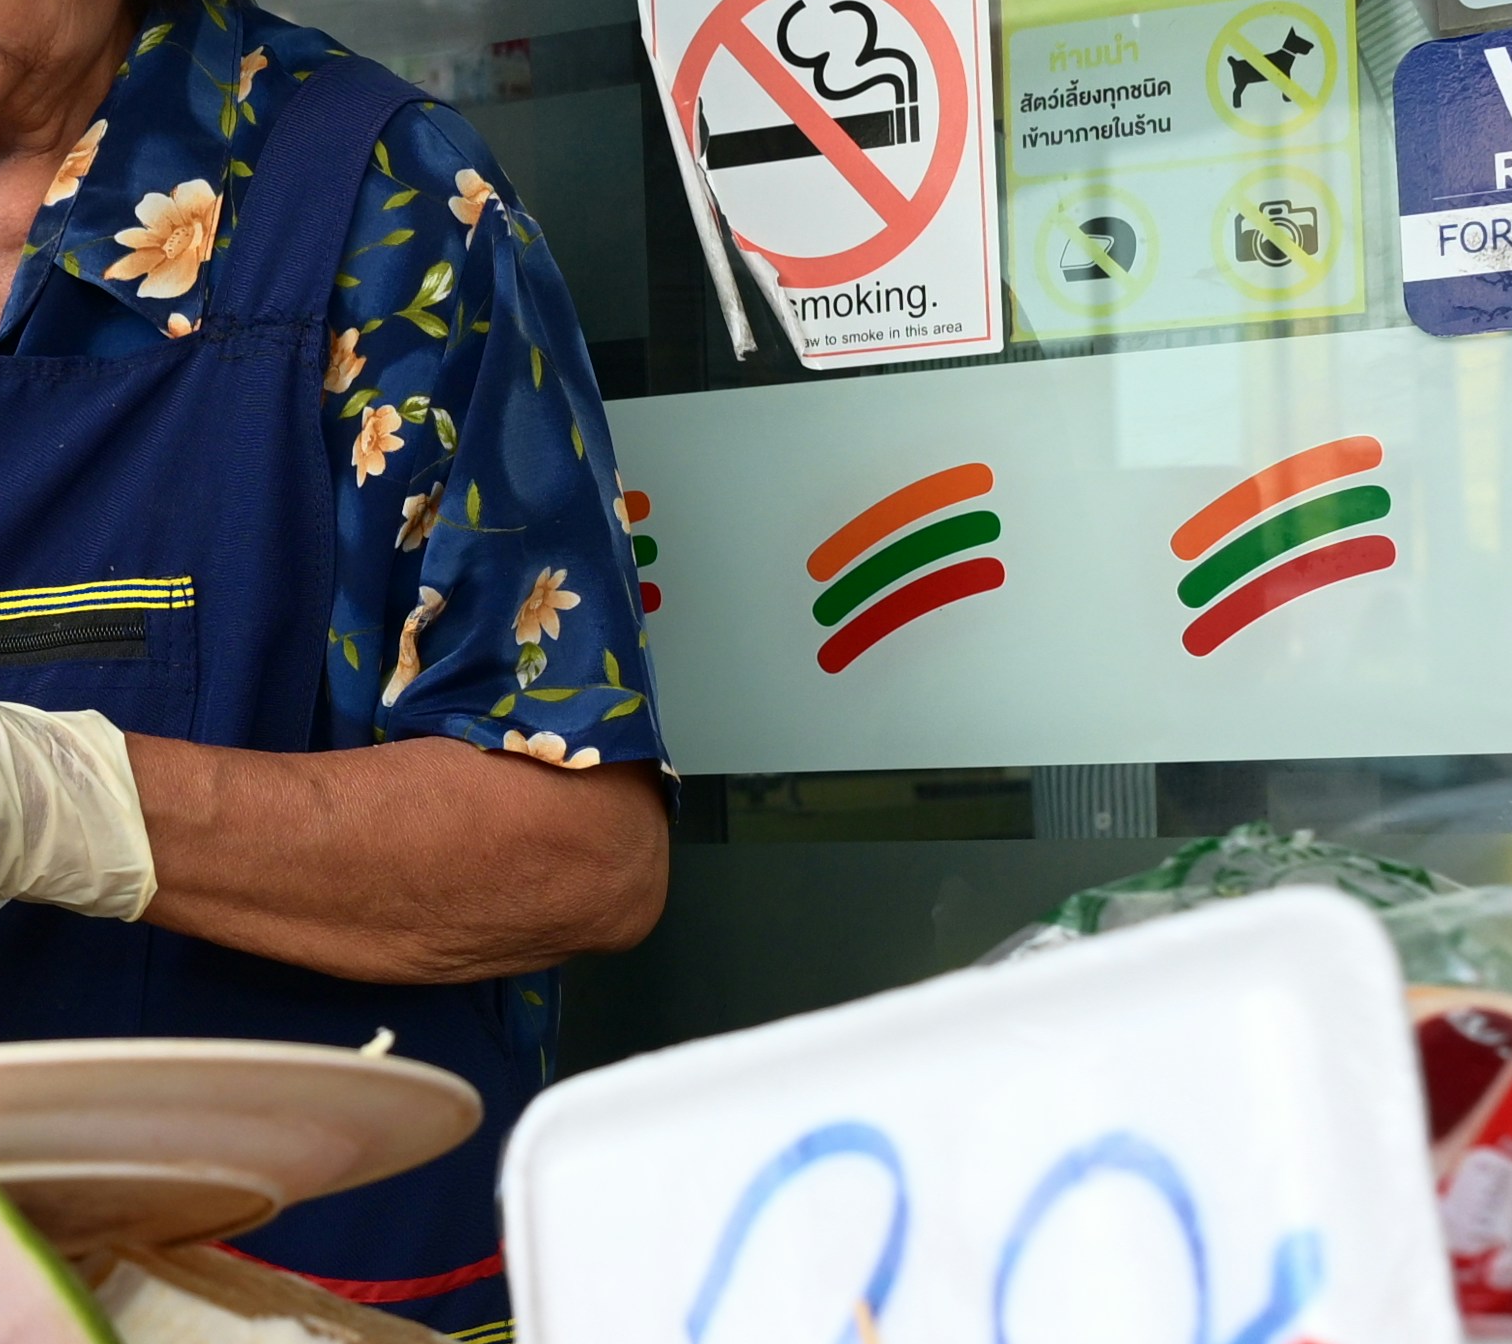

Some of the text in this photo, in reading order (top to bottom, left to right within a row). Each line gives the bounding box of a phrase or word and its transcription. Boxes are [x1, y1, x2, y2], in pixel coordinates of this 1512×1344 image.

[1049, 32, 1140, 73] ห้ามนำ
[1020, 77, 1171, 114] สัตว์เลี้ยงทุกชนิด
[1022, 113, 1171, 149] เข้ามาภายในร้าน
[826, 334, 836, 346] to
[842, 329, 884, 344] smoke
[889, 326, 900, 340] in
[906, 323, 928, 338] this
[933, 322, 962, 335] area
